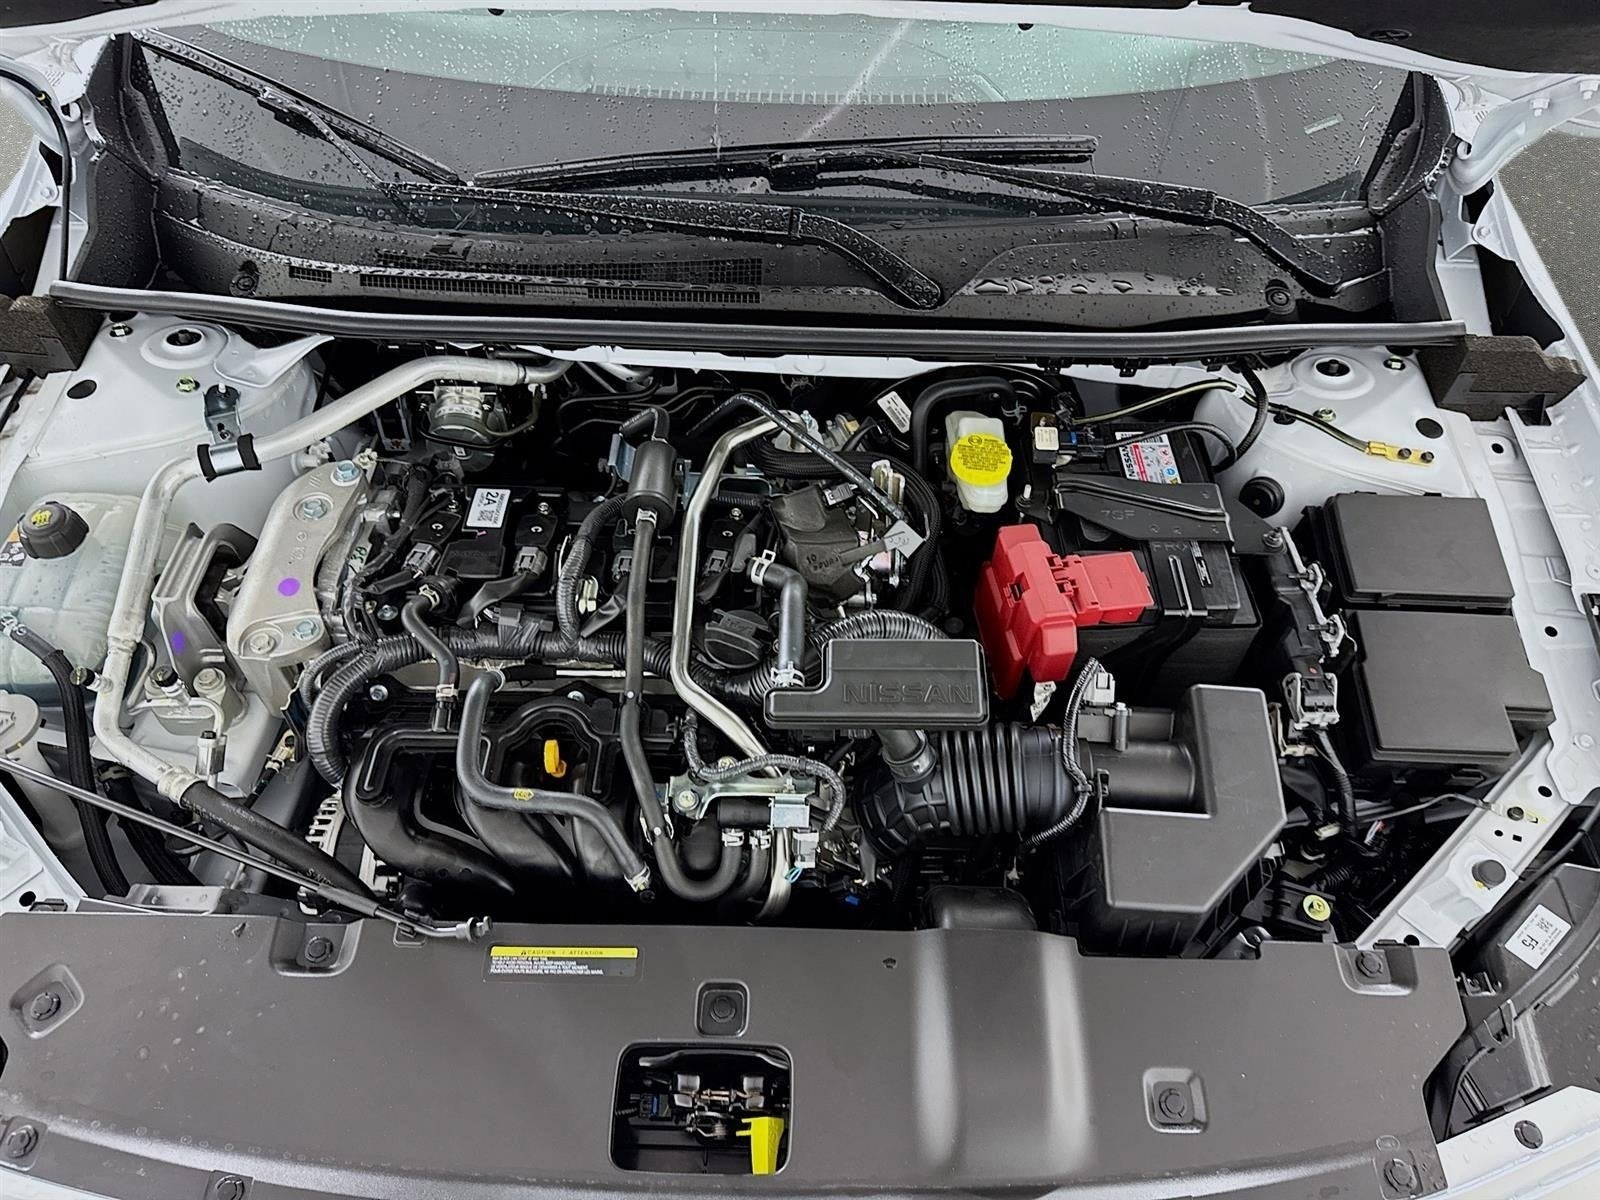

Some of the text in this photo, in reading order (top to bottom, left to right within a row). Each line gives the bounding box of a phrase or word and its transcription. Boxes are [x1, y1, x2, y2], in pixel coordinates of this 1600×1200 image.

[1121, 445, 1137, 478] NISSAN
[483, 491, 500, 507] 2A
[842, 681, 974, 704] NISSAN
[1521, 934, 1539, 951] F5
